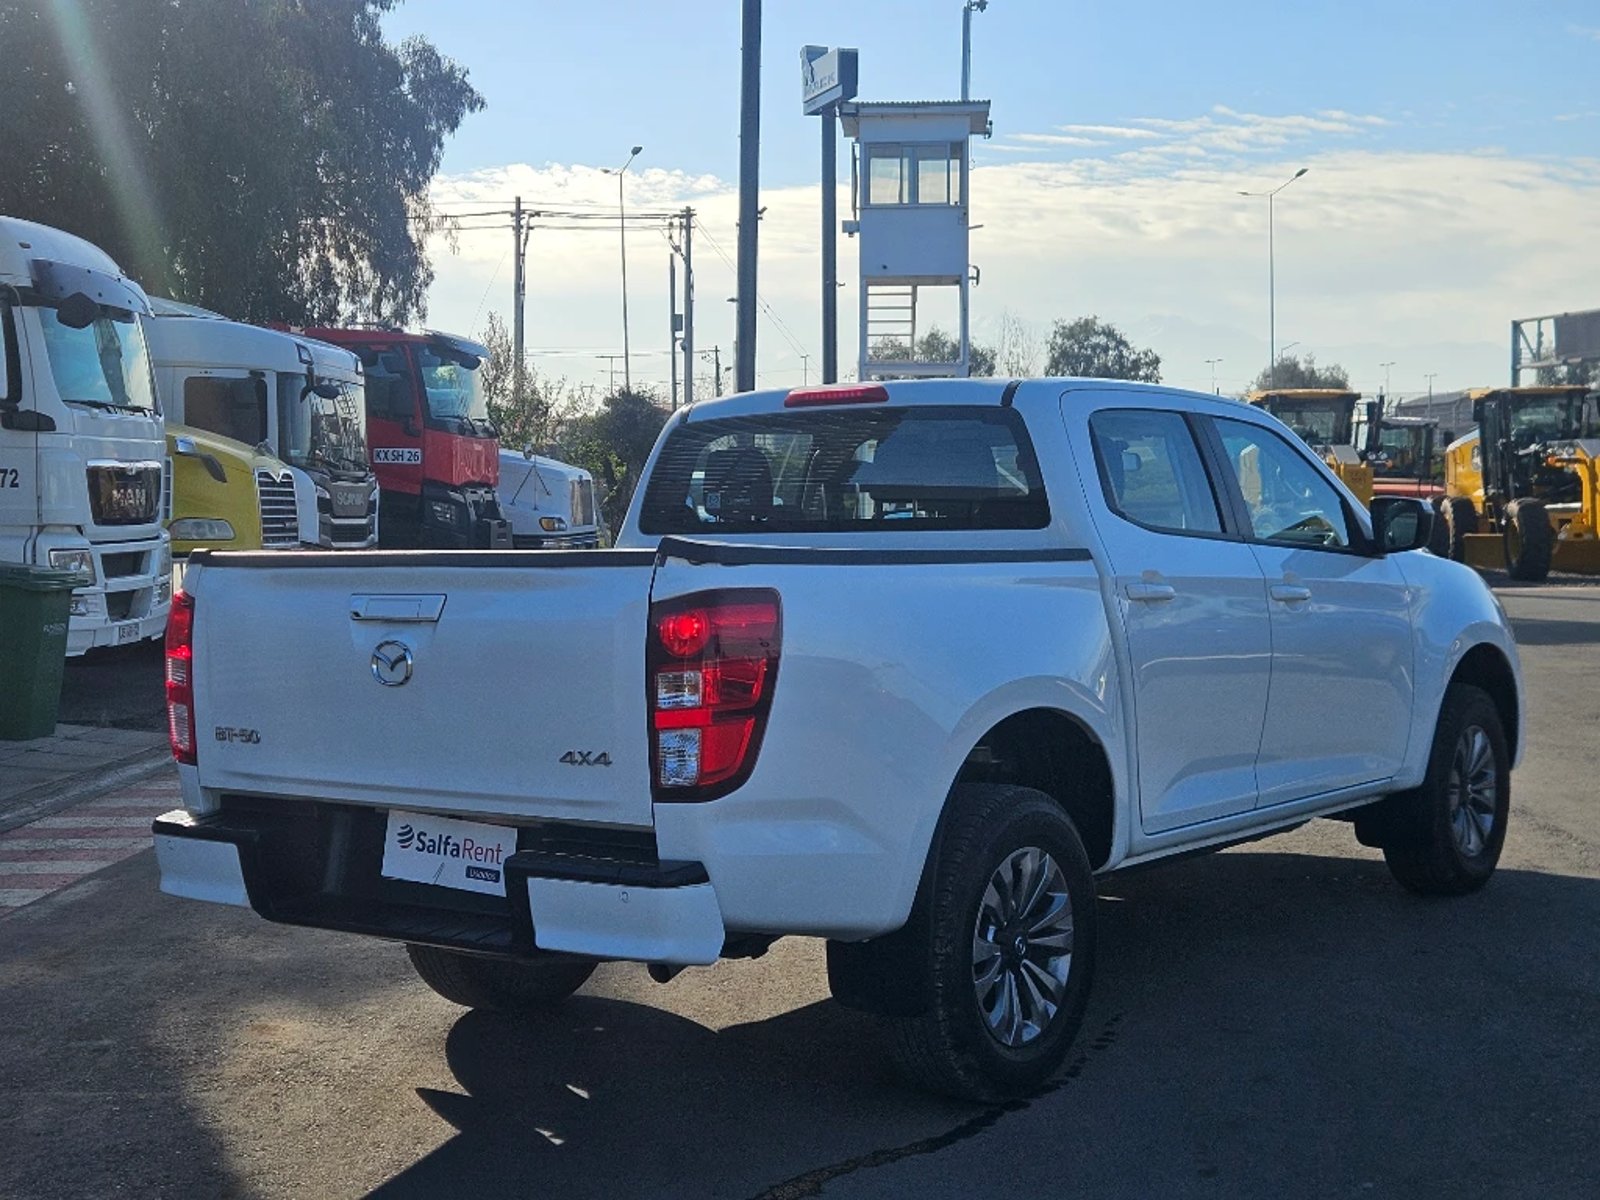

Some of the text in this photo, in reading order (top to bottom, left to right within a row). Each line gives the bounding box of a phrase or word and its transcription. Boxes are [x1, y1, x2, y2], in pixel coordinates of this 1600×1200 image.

[406, 450, 420, 462] 26
[0, 468, 19, 488] 72
[112, 488, 146, 507] MAN
[336, 491, 365, 506] SCANIA
[215, 726, 261, 744] BT-50
[415, 831, 503, 864] SalfaRent
